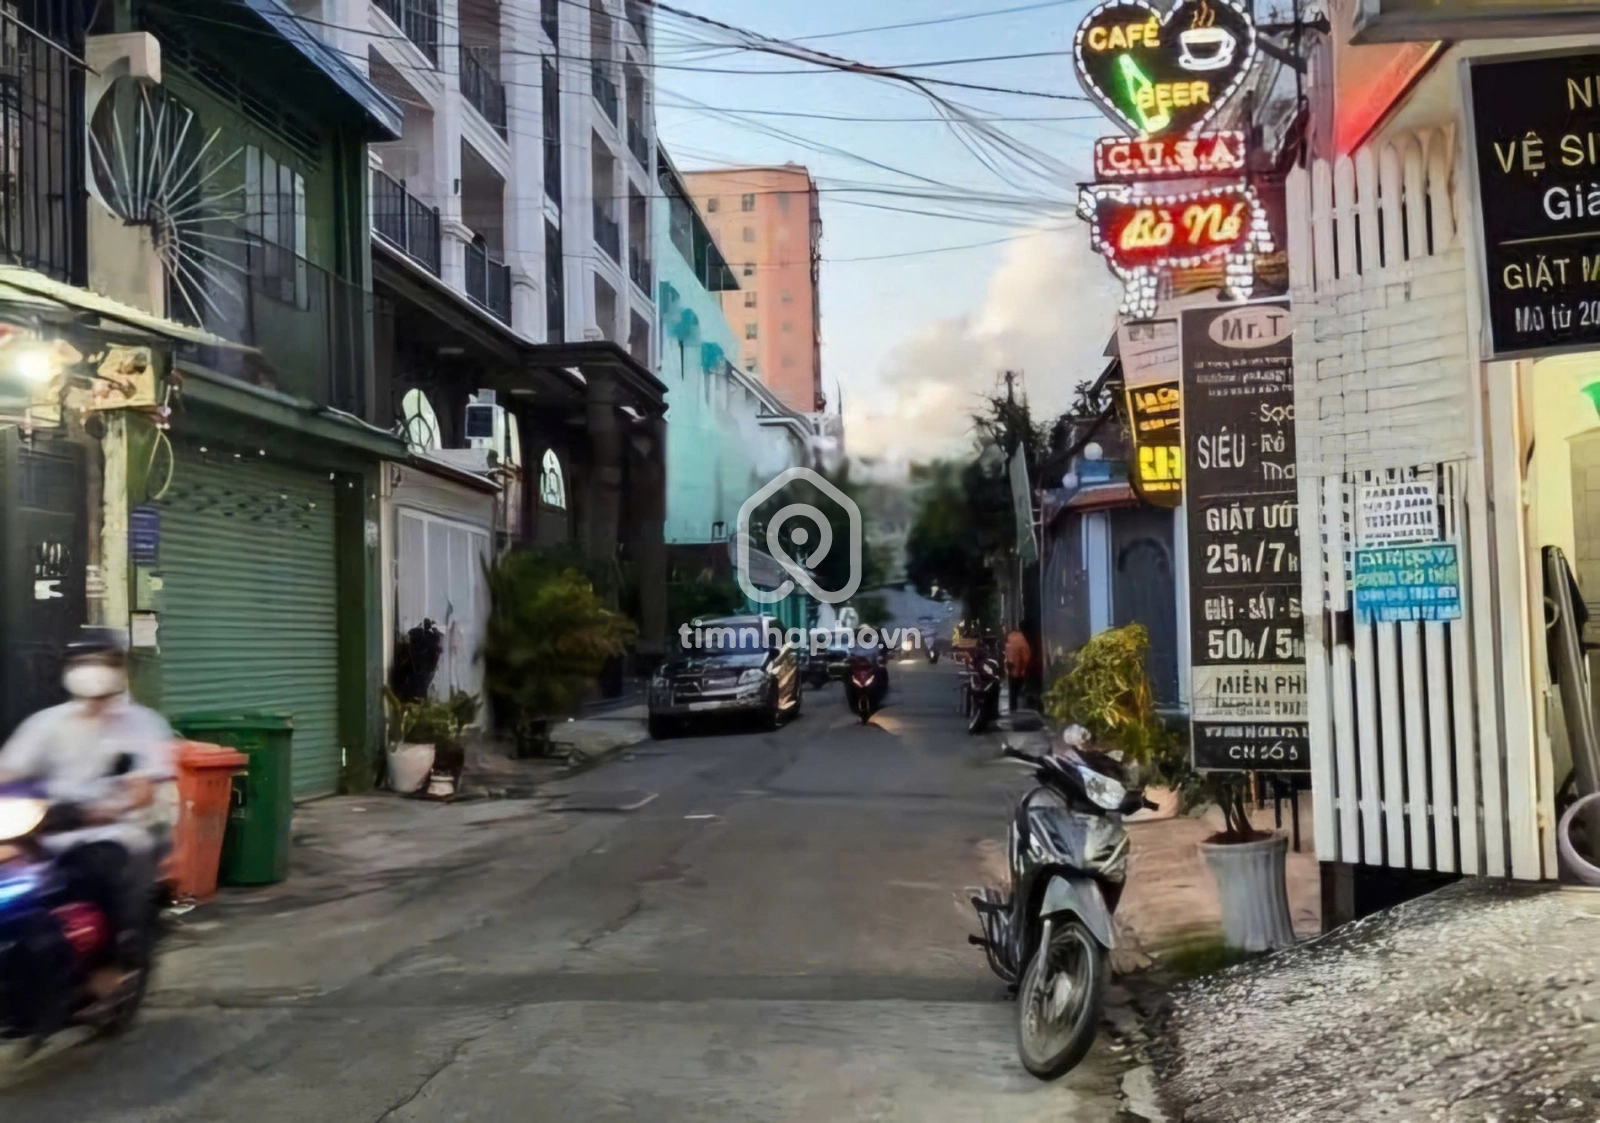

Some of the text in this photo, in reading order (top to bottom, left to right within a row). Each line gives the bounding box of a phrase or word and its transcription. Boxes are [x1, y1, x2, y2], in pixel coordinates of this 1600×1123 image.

[1088, 16, 1160, 50] CAFÉ
[1136, 81, 1211, 109] BEER
[1494, 131, 1545, 177] VỆ
